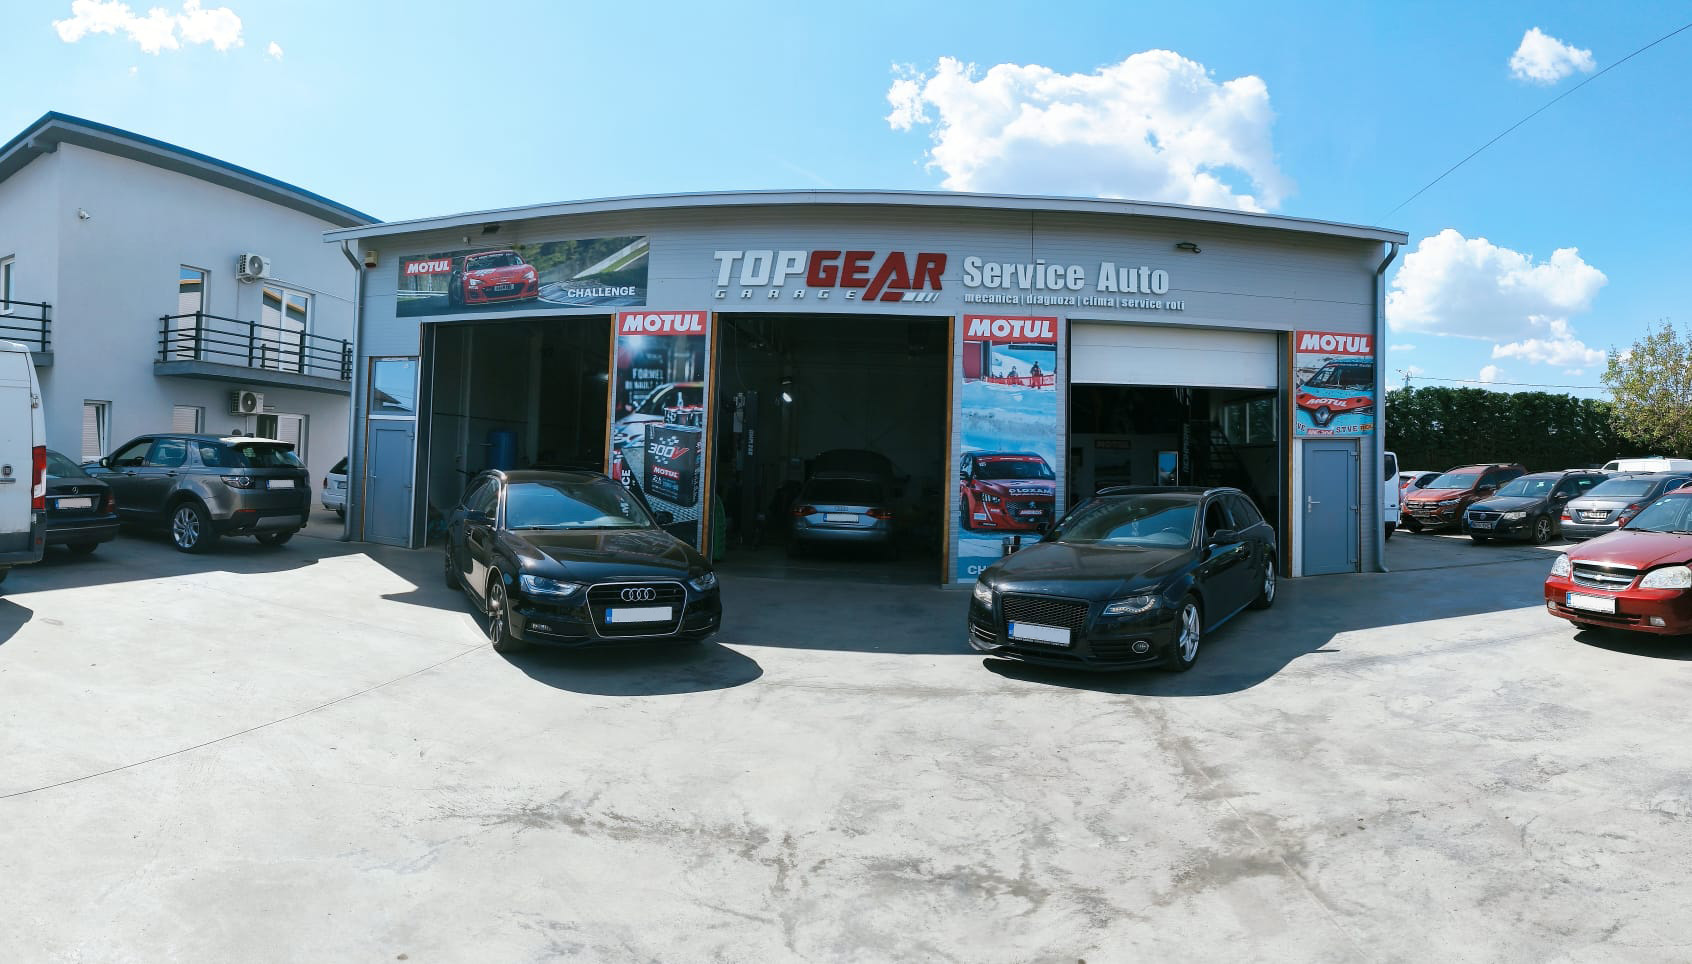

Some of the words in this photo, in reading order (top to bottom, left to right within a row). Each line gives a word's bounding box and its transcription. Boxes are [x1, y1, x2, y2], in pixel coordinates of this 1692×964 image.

[407, 260, 450, 275] MOTUL
[963, 256, 1085, 290] Service
[1097, 261, 1169, 295] Auto
[568, 286, 636, 298] CHALLENGE
[714, 289, 857, 300] GARAGE
[965, 293, 1019, 305] mecanica
[1026, 294, 1075, 307] diagnoza
[1083, 296, 1114, 307] clima
[1166, 300, 1185, 311] roti
[622, 314, 702, 332] MOTUL
[968, 319, 1053, 338] MOTUL
[1300, 334, 1370, 353] MOTUL
[1306, 398, 1347, 407] MOTUL
[653, 466, 679, 478] MOTUL
